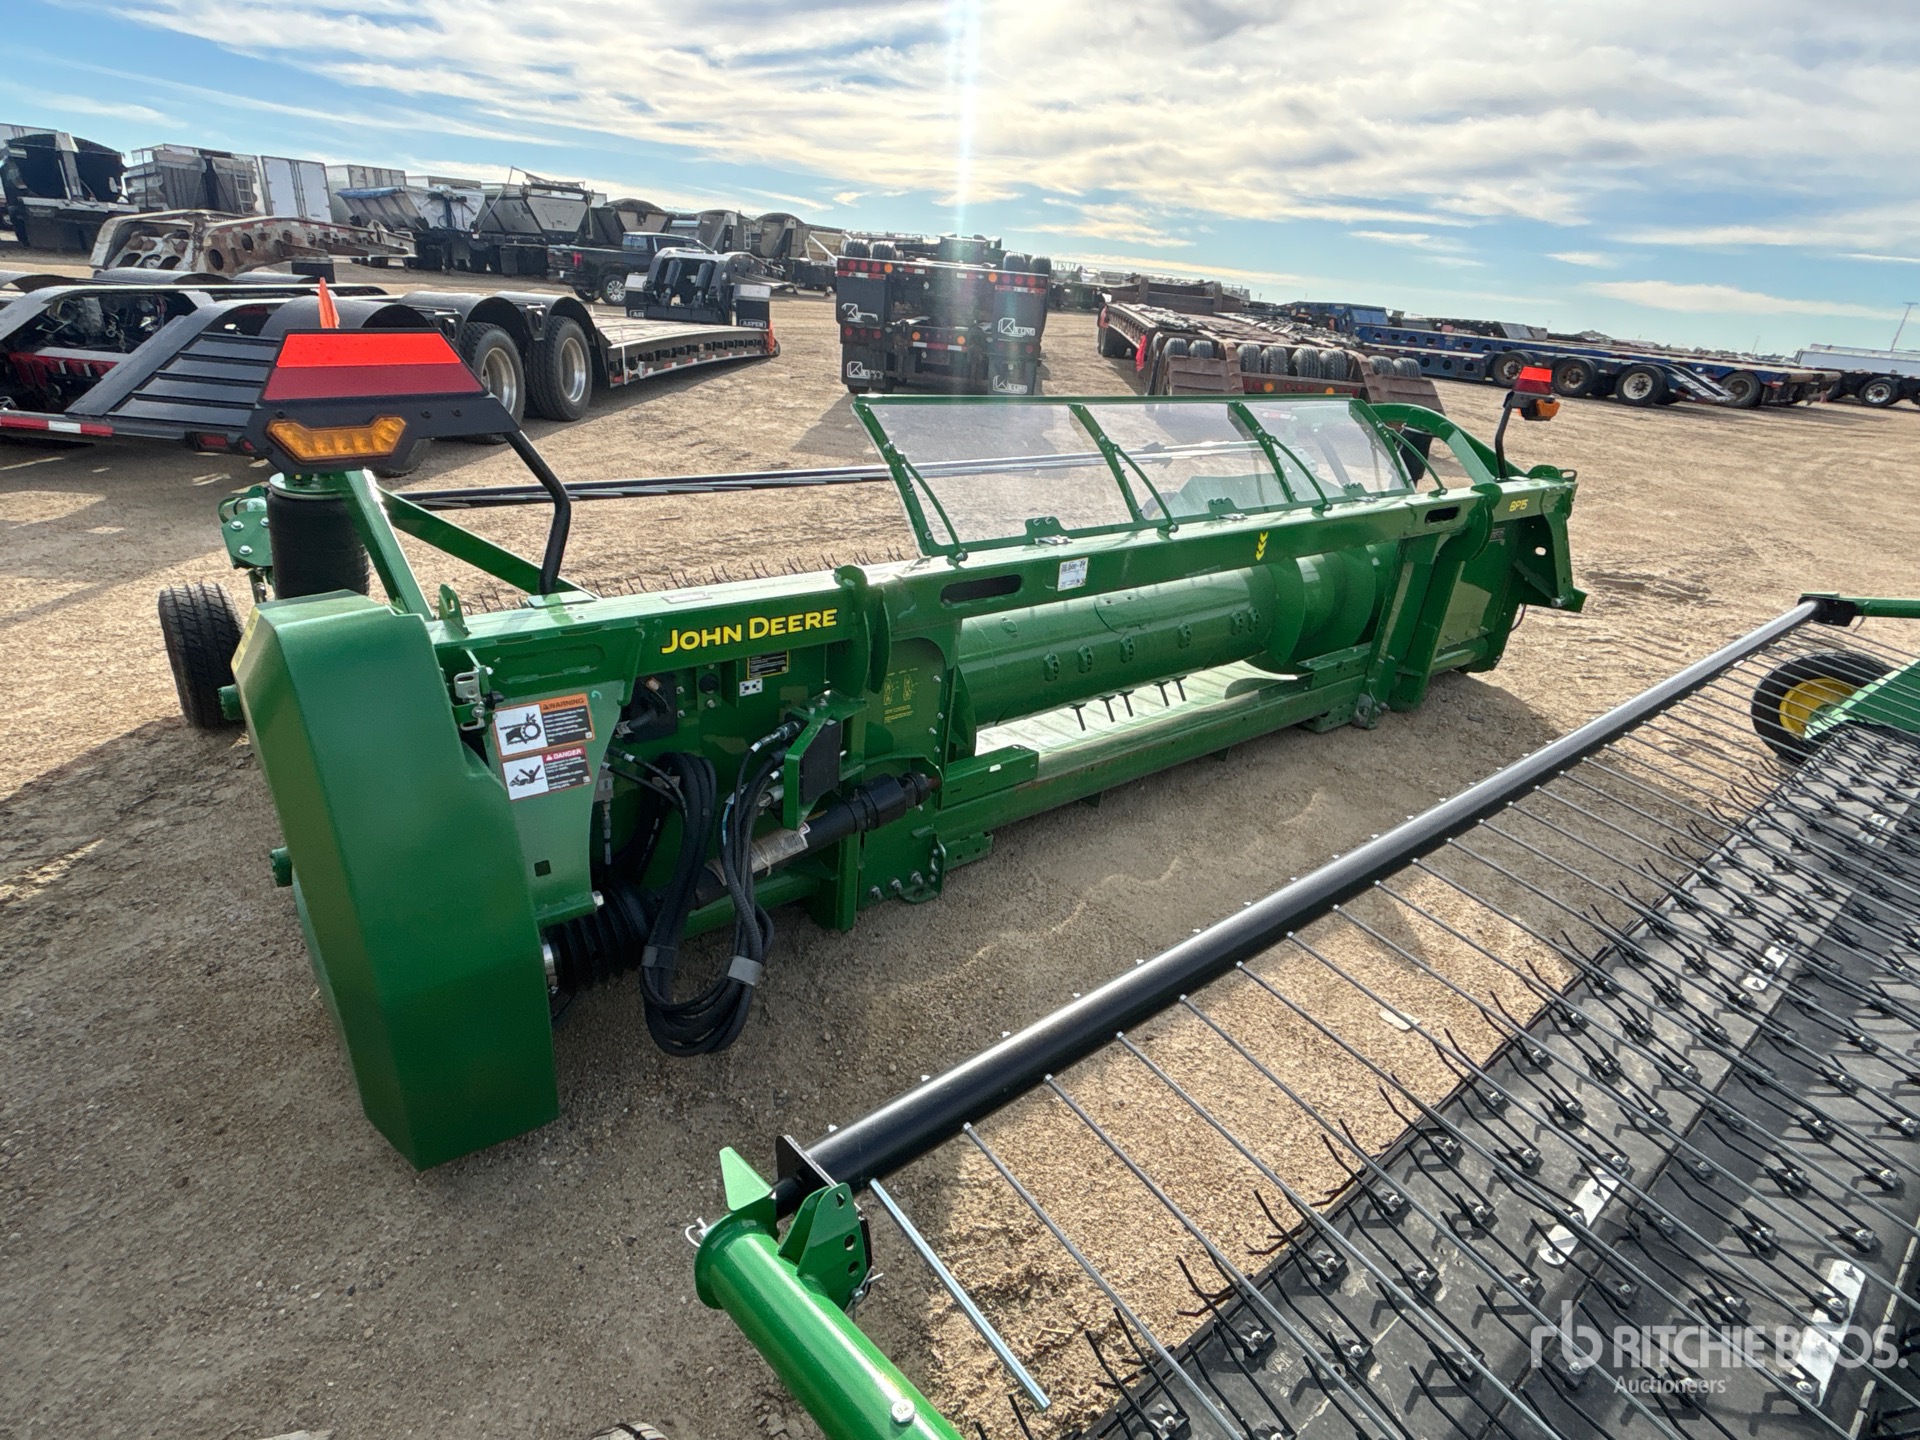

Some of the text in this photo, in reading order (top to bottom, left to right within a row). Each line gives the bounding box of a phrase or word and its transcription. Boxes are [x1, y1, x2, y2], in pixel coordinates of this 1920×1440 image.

[742, 320, 764, 328] ASPEN
[1509, 498, 1529, 512] BP15
[661, 608, 838, 654] JOHN DEERE
[549, 697, 584, 709] WARNING
[553, 748, 582, 760] DANGER
